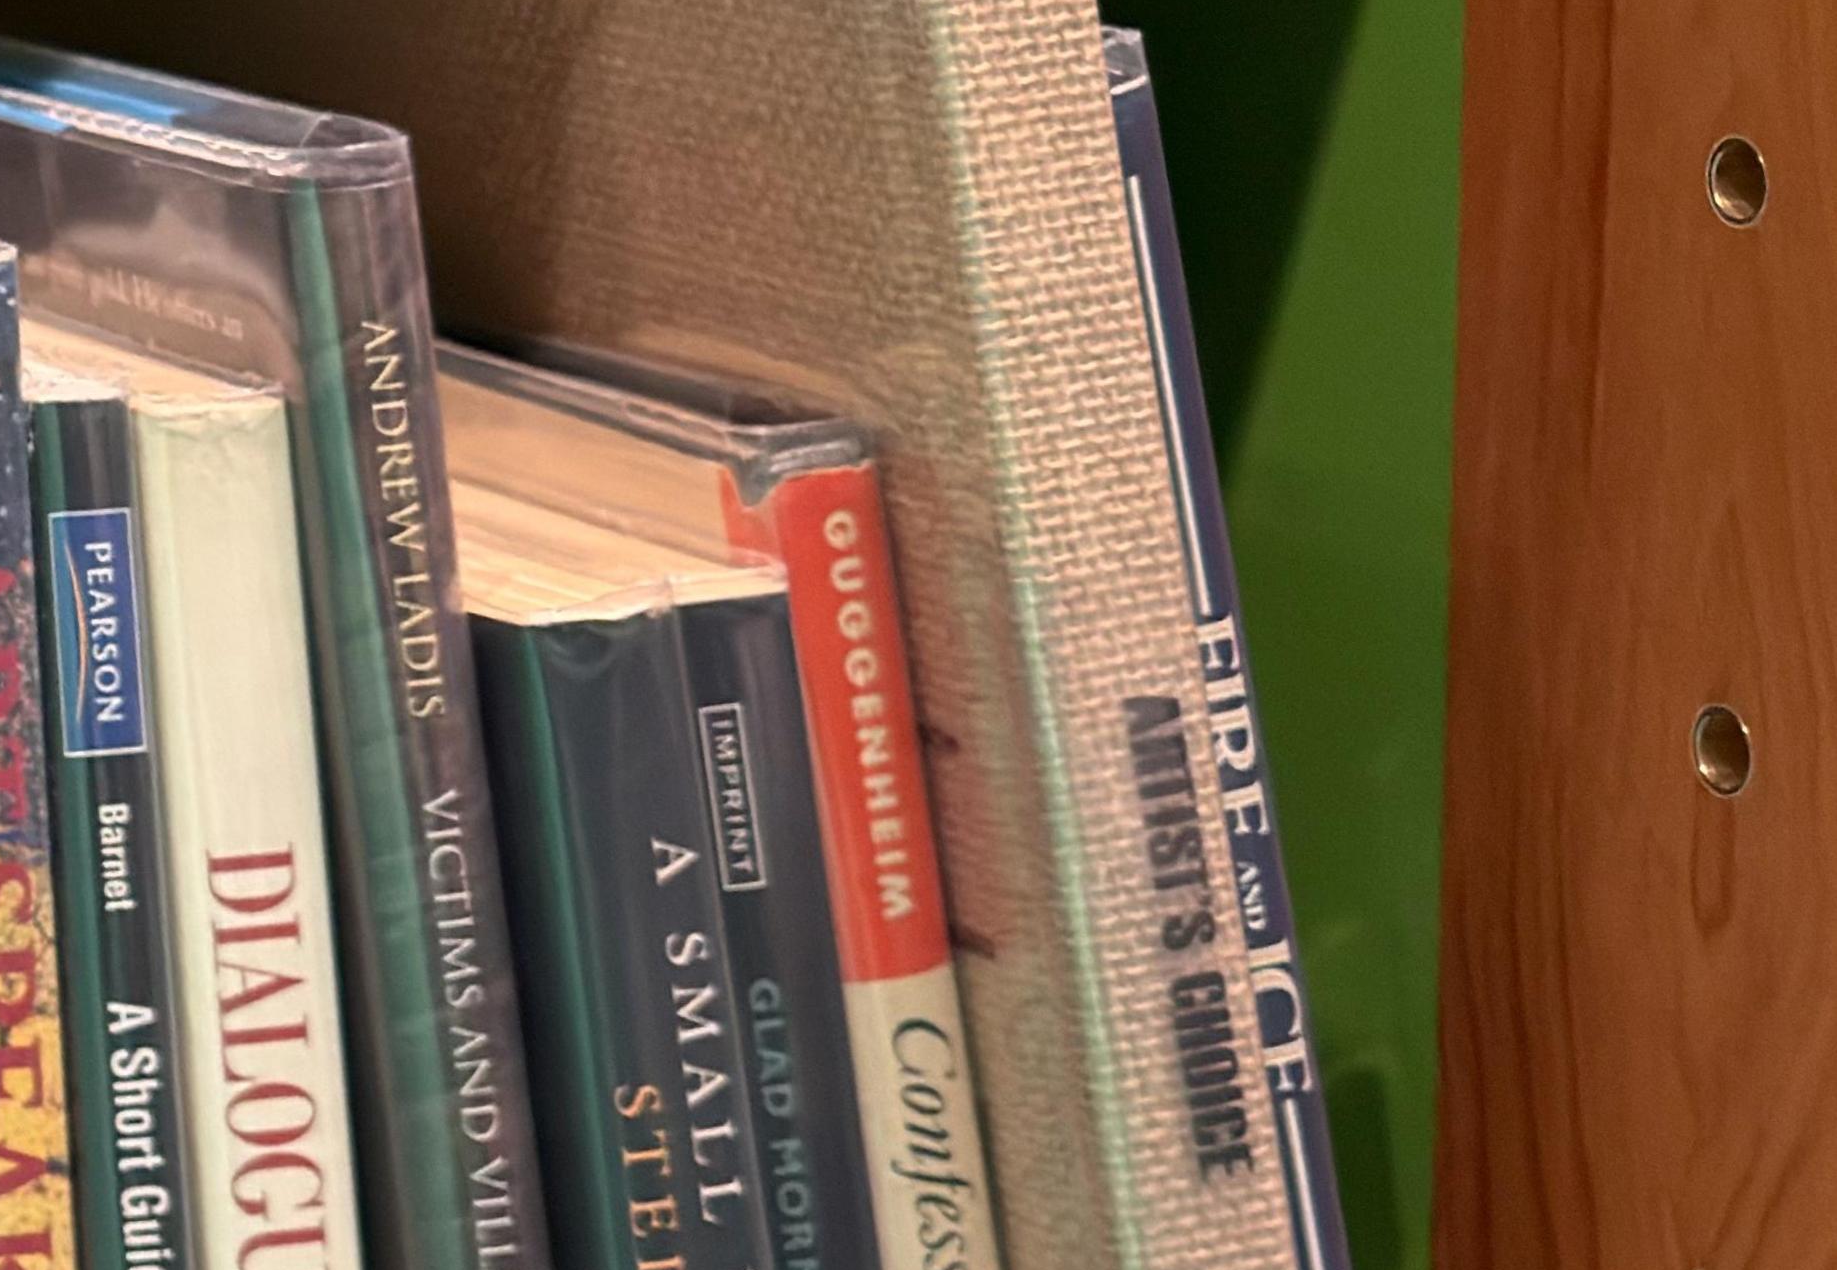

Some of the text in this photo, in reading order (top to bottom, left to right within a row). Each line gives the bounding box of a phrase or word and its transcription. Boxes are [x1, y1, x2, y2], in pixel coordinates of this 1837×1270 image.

[360, 318, 447, 718] ANDREW LADIS
[85, 541, 125, 723] PEARSON
[824, 509, 915, 921] GUGGENHEIM
[97, 802, 135, 911] Barnet
[711, 718, 754, 875] IMPRINT
[420, 789, 485, 1008] VICTIMS
[1238, 862, 1268, 930] AND
[111, 1048, 166, 1171] Short
[665, 932, 747, 1224] SMALL
[1171, 971, 1256, 1178] CHOICE
